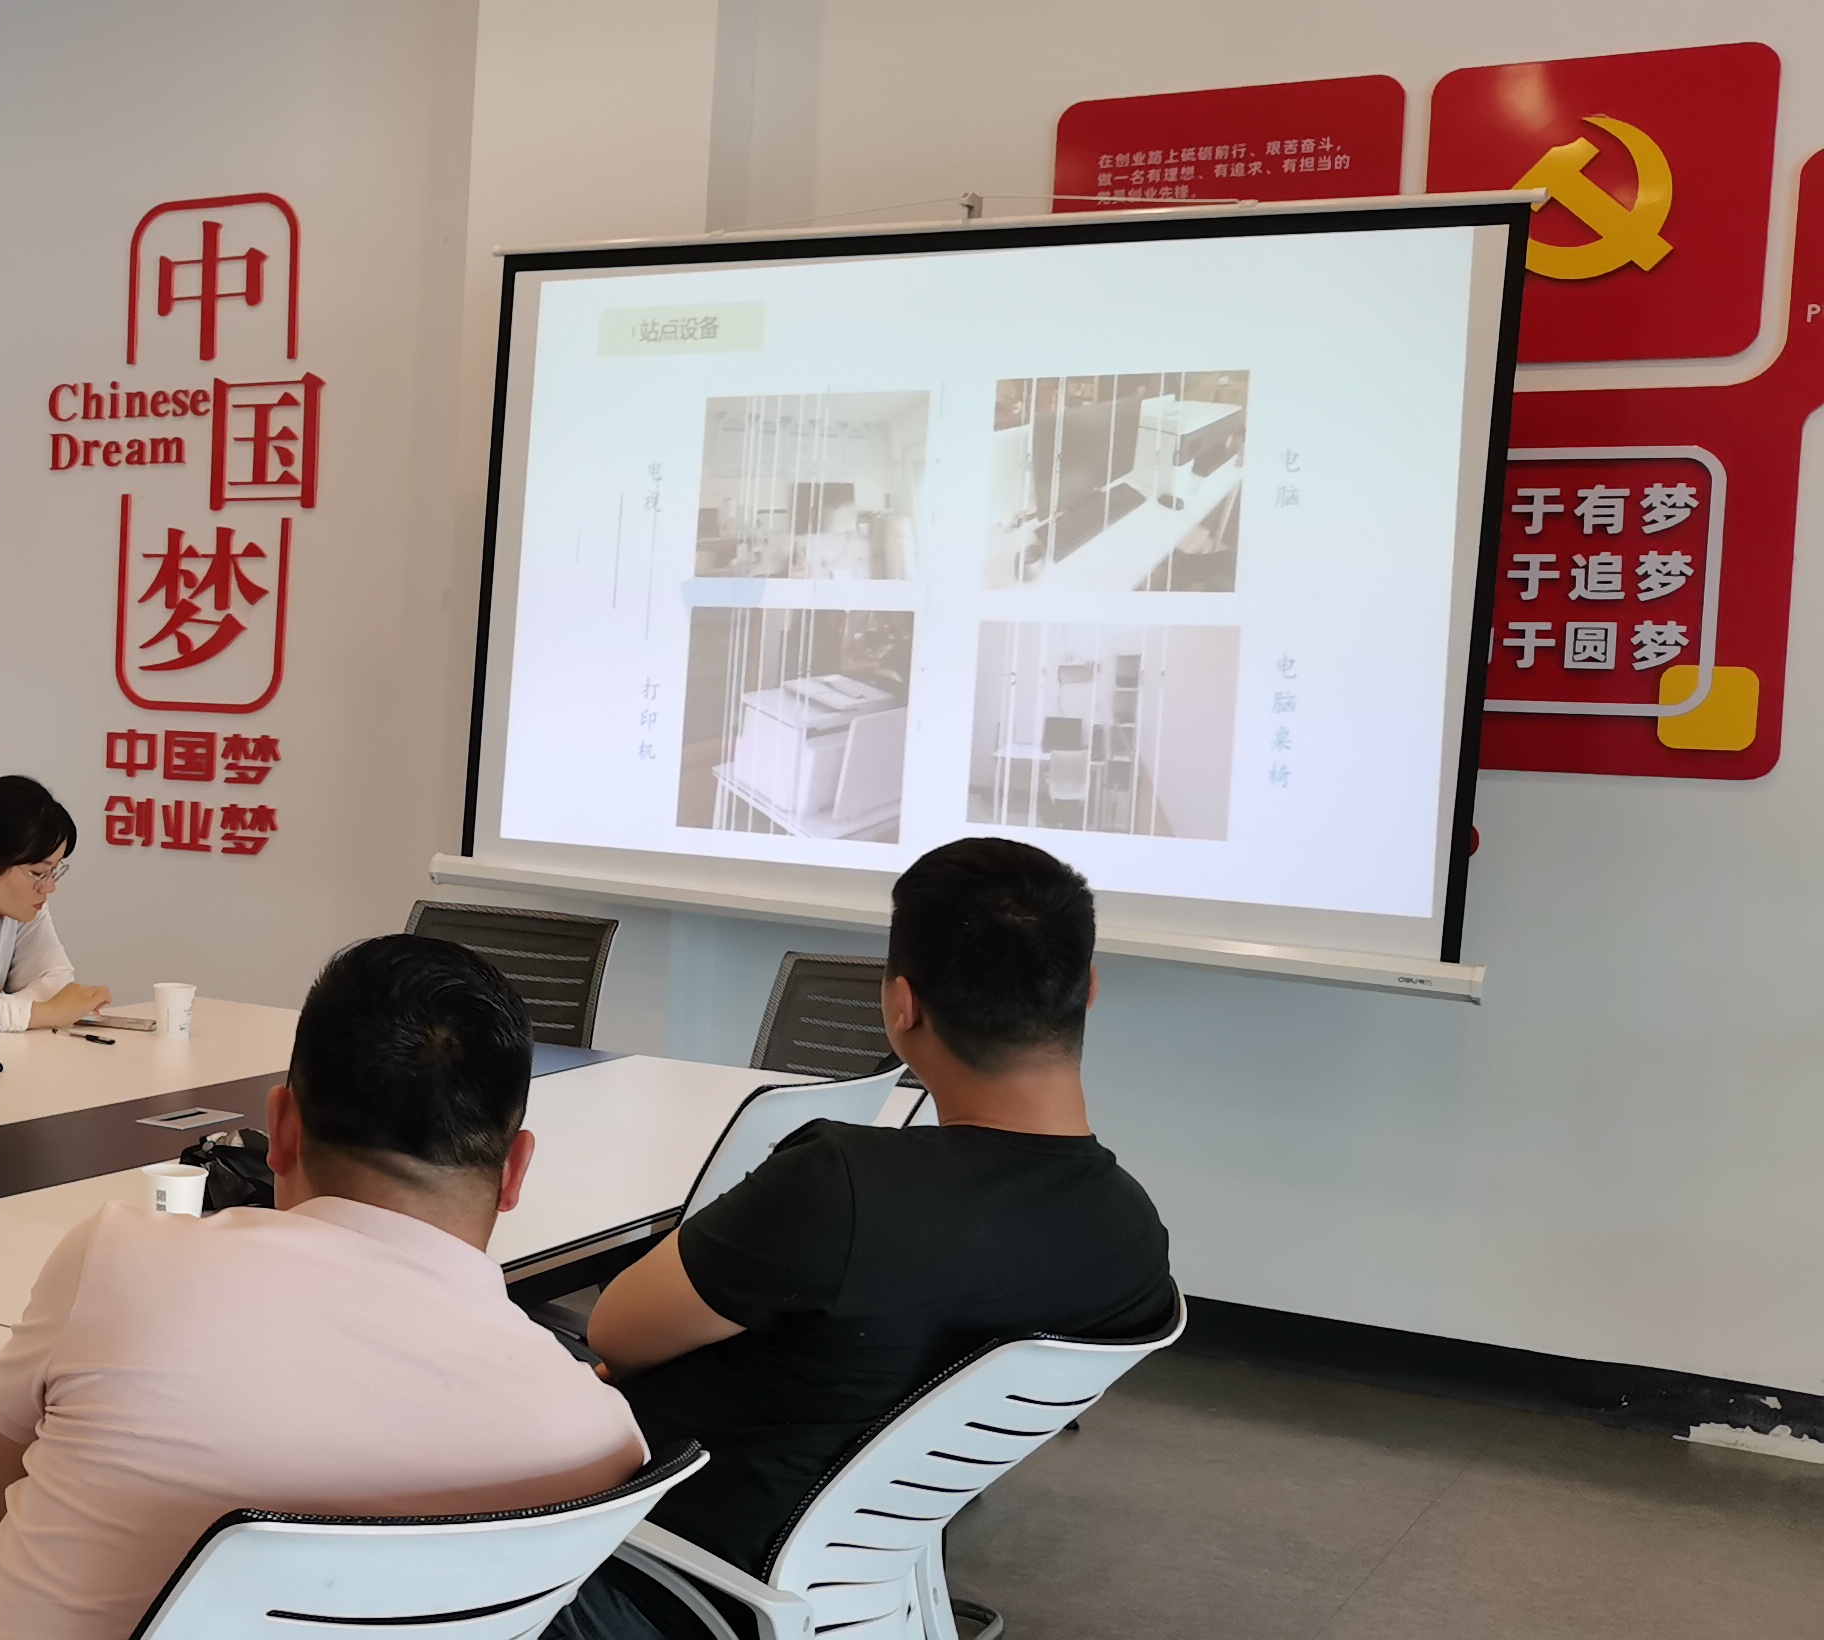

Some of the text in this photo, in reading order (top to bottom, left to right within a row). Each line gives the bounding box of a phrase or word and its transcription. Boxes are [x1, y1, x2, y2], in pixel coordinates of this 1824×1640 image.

[638, 315, 720, 344] 站点设备
[48, 381, 212, 421] Chinese
[49, 433, 186, 471] Dream
[138, 220, 326, 672] 中国梦
[1511, 482, 1700, 535] 于有梦
[1507, 550, 1695, 602] 于追梦
[1487, 620, 1690, 672] 于圆梦
[105, 729, 282, 785] 中国梦
[104, 796, 279, 856] 创业梦
